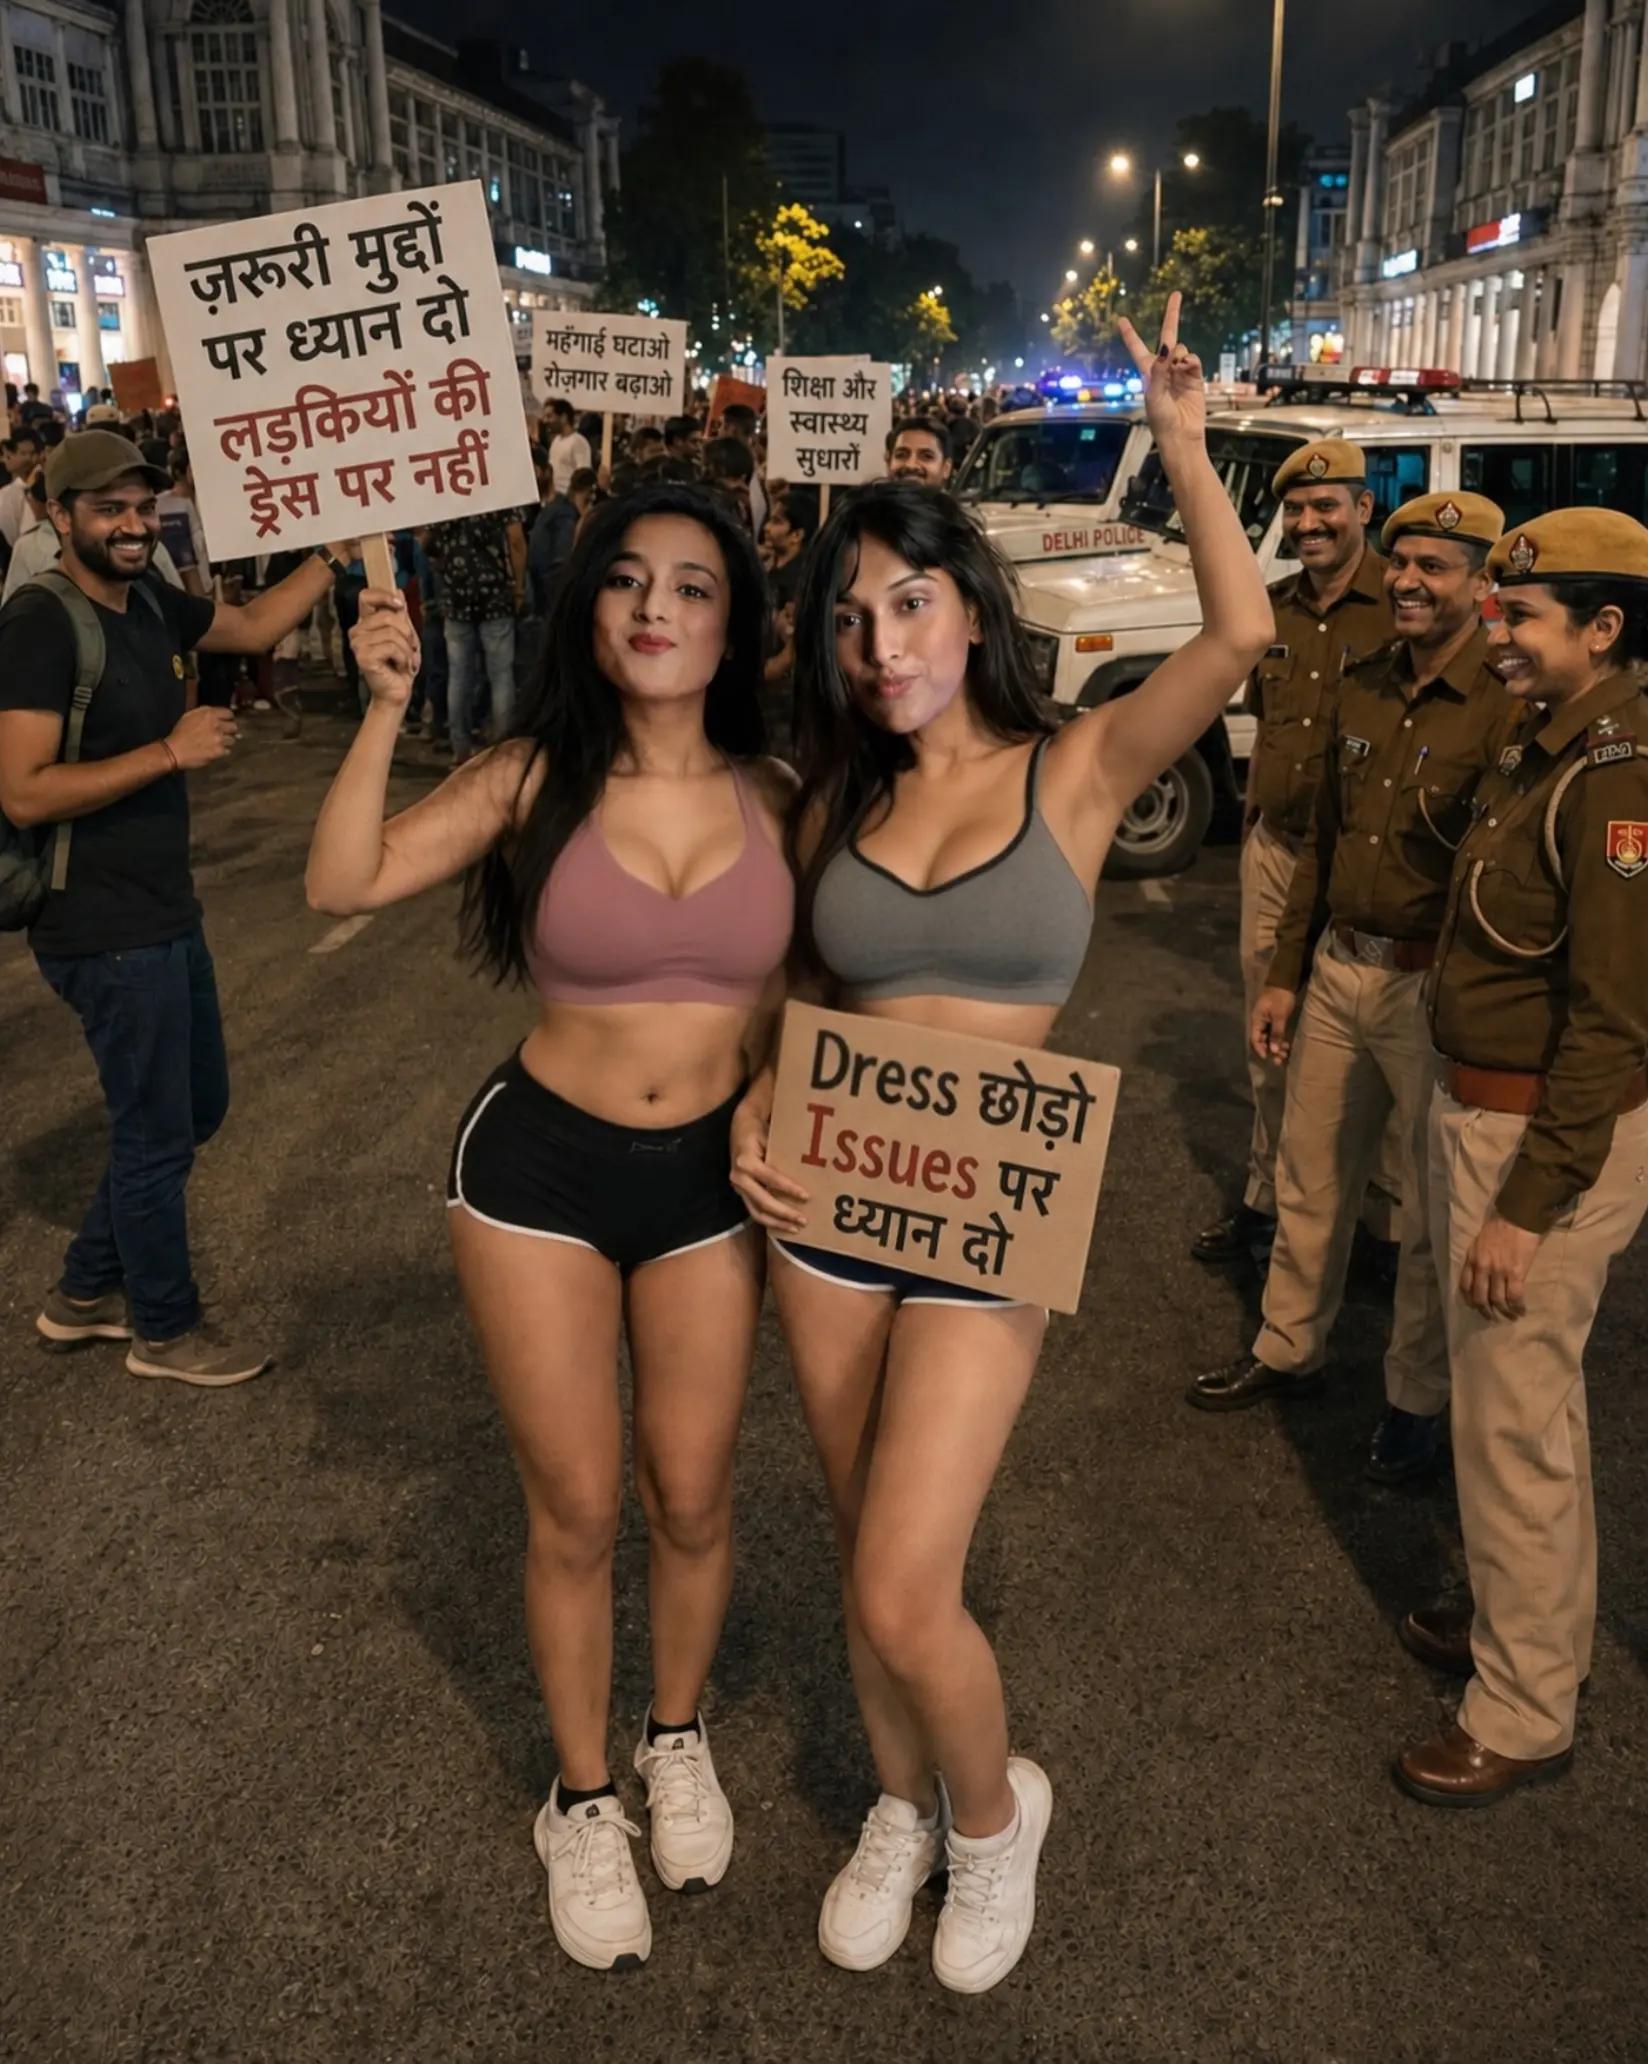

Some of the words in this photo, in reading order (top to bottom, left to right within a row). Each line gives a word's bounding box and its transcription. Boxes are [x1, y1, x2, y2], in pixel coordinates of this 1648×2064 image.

[348, 200, 442, 294] मुद्दों
[201, 329, 267, 379] पर
[286, 302, 403, 361] ध्यान
[417, 274, 470, 344] दो
[613, 332, 670, 359] घटाओ
[213, 369, 416, 465] लड़कियों
[428, 358, 491, 421] की
[782, 367, 836, 399] शिक्षा
[842, 370, 877, 400] और
[789, 411, 869, 435] स्वास्थ्य
[243, 465, 320, 538] ड्रेस
[335, 459, 395, 507] पर
[408, 428, 490, 496] नहीं
[795, 442, 861, 477] सुधारों
[1042, 531, 1088, 552] DELHI
[1093, 526, 1145, 547] POLICE
[810, 1029, 960, 1117] Dress
[978, 1059, 1097, 1151] छोड़ो
[800, 1103, 979, 1200] Issues
[998, 1160, 1061, 1217] पर
[833, 1194, 947, 1260] ध्यान
[962, 1211, 1014, 1276] दो
